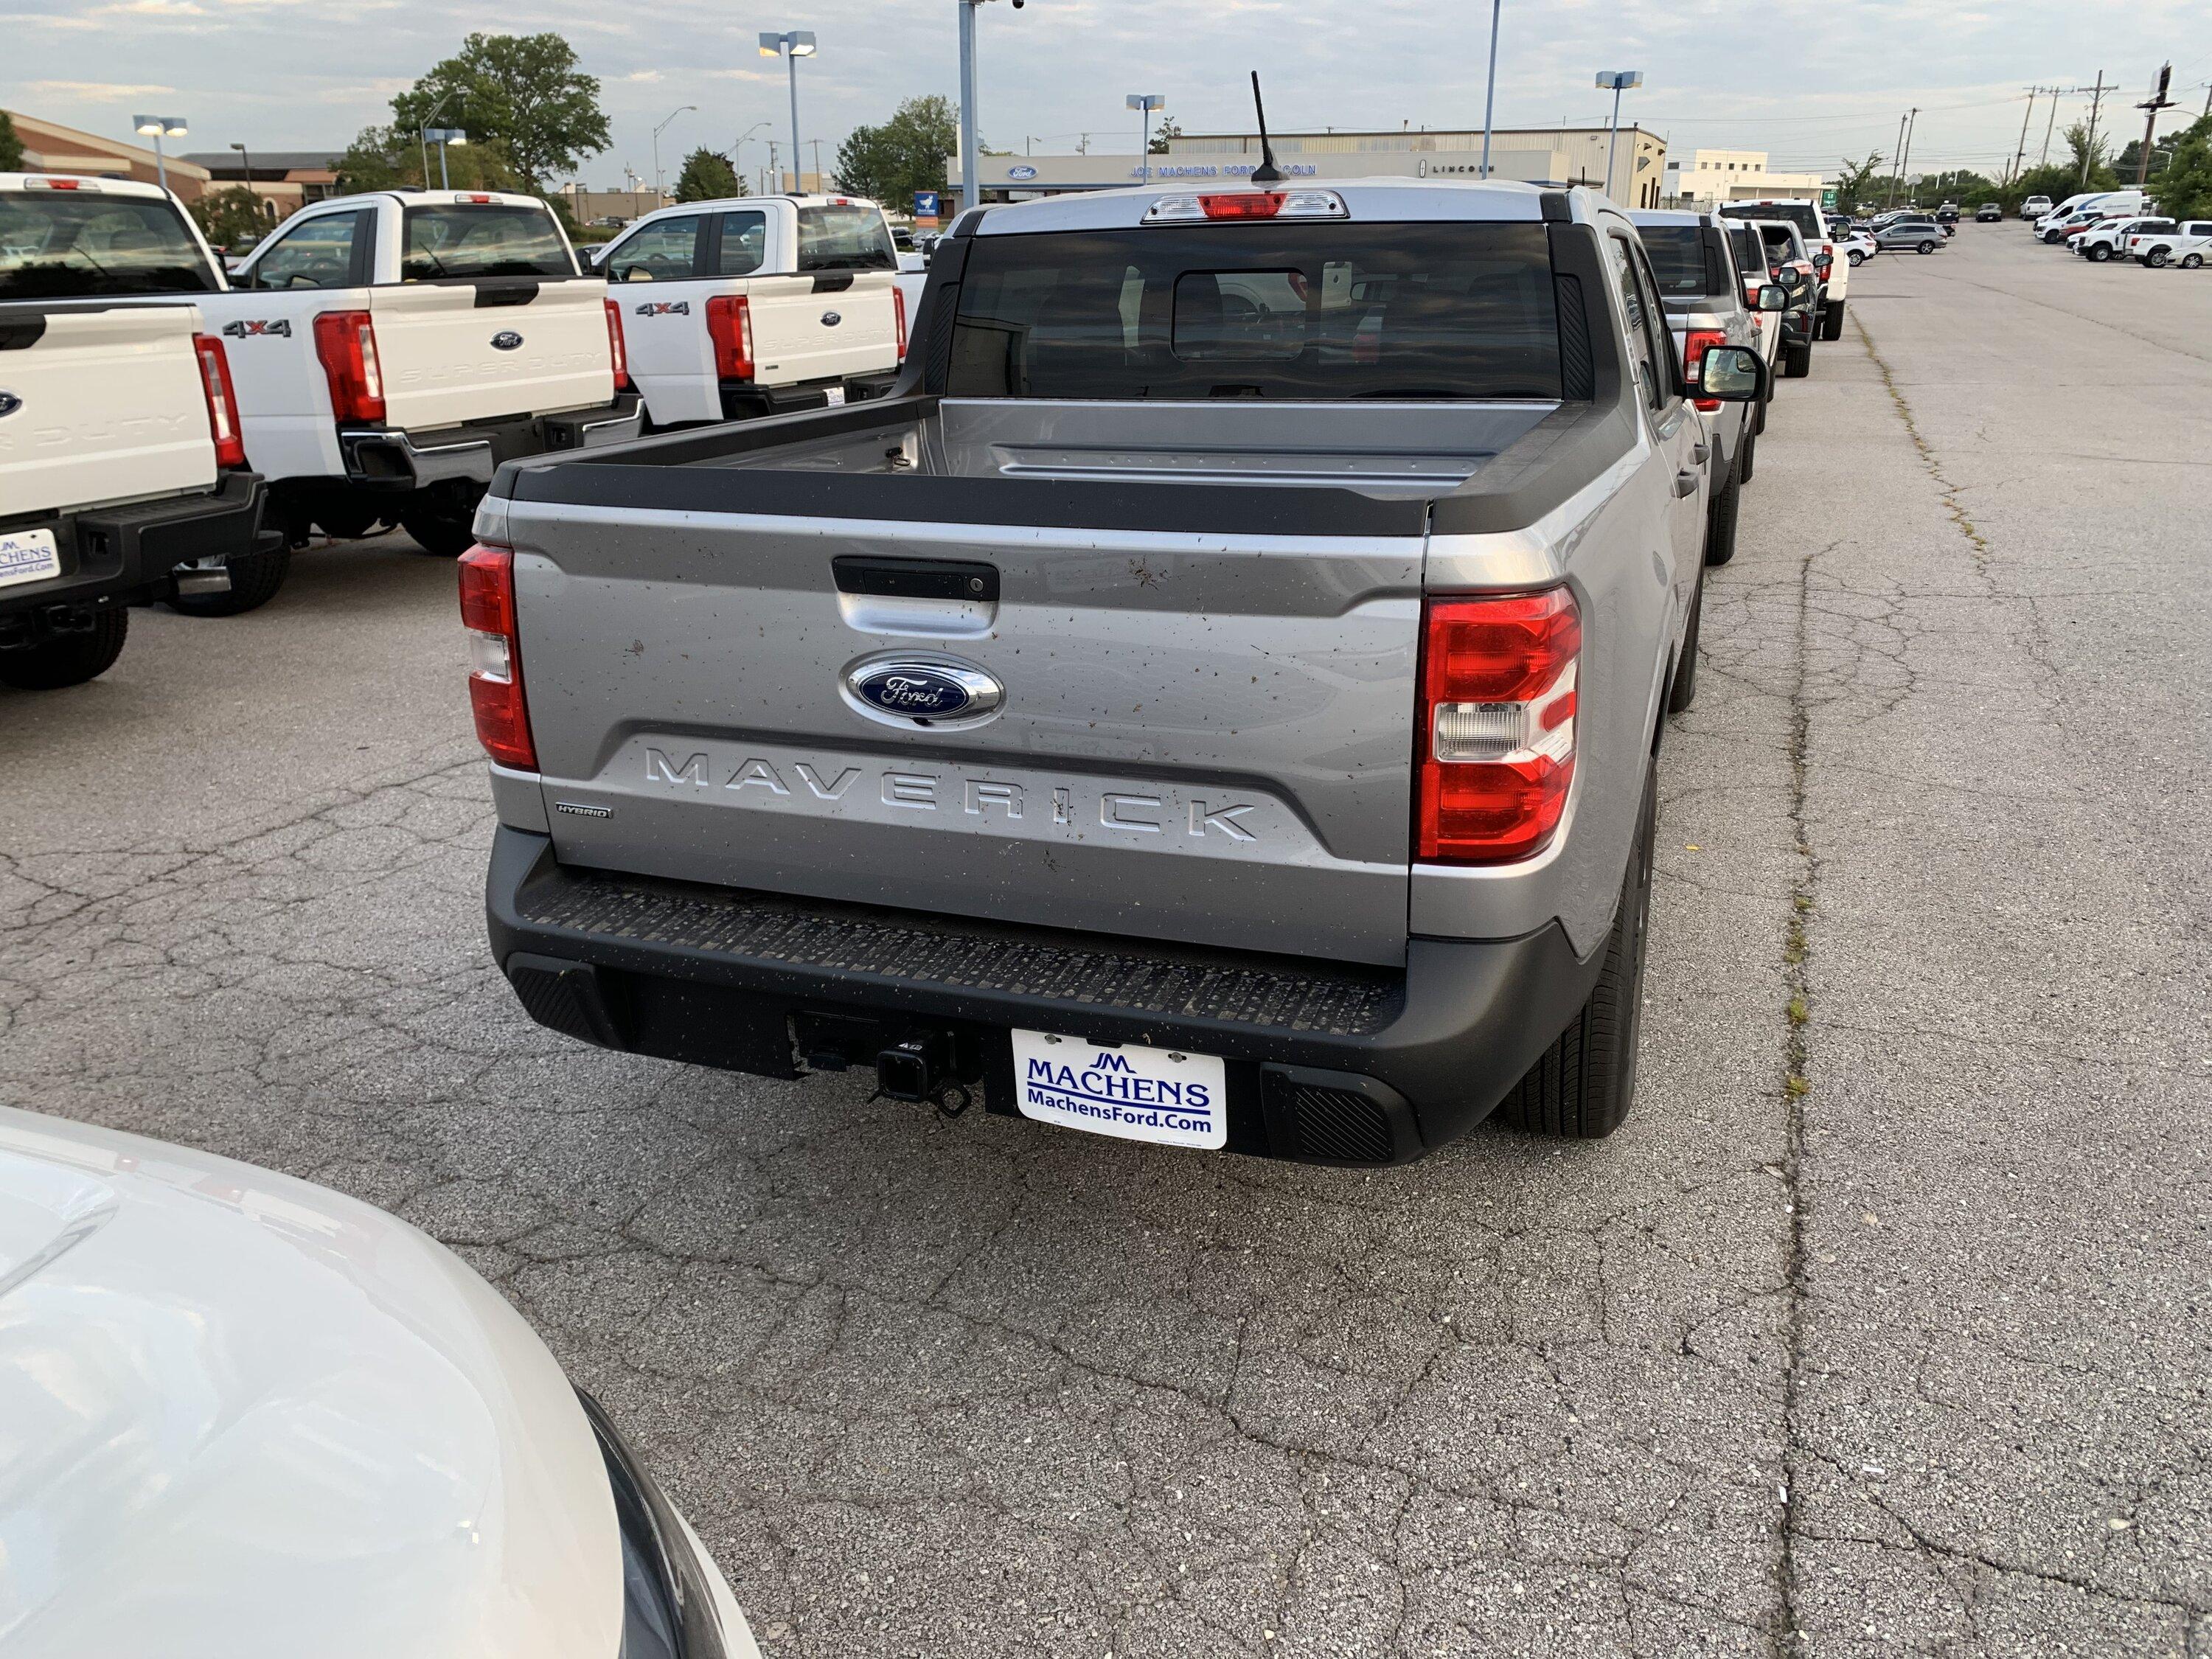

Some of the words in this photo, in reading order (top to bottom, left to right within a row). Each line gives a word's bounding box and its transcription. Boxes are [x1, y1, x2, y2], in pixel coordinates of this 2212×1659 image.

[1012, 167, 1034, 178] Ford
[1130, 167, 1152, 176] JOE
[1158, 166, 1217, 176] MACHENS
[1223, 165, 1256, 175] FORD
[33, 413, 188, 446] DUTY
[0, 546, 52, 565] CHENS
[880, 676, 947, 708] Ford
[645, 747, 1256, 841] MAVERICK
[557, 805, 608, 818] HYBRID
[1026, 1057, 1211, 1107] MACHENS
[1027, 1088, 1212, 1133] MachensFord.Com
